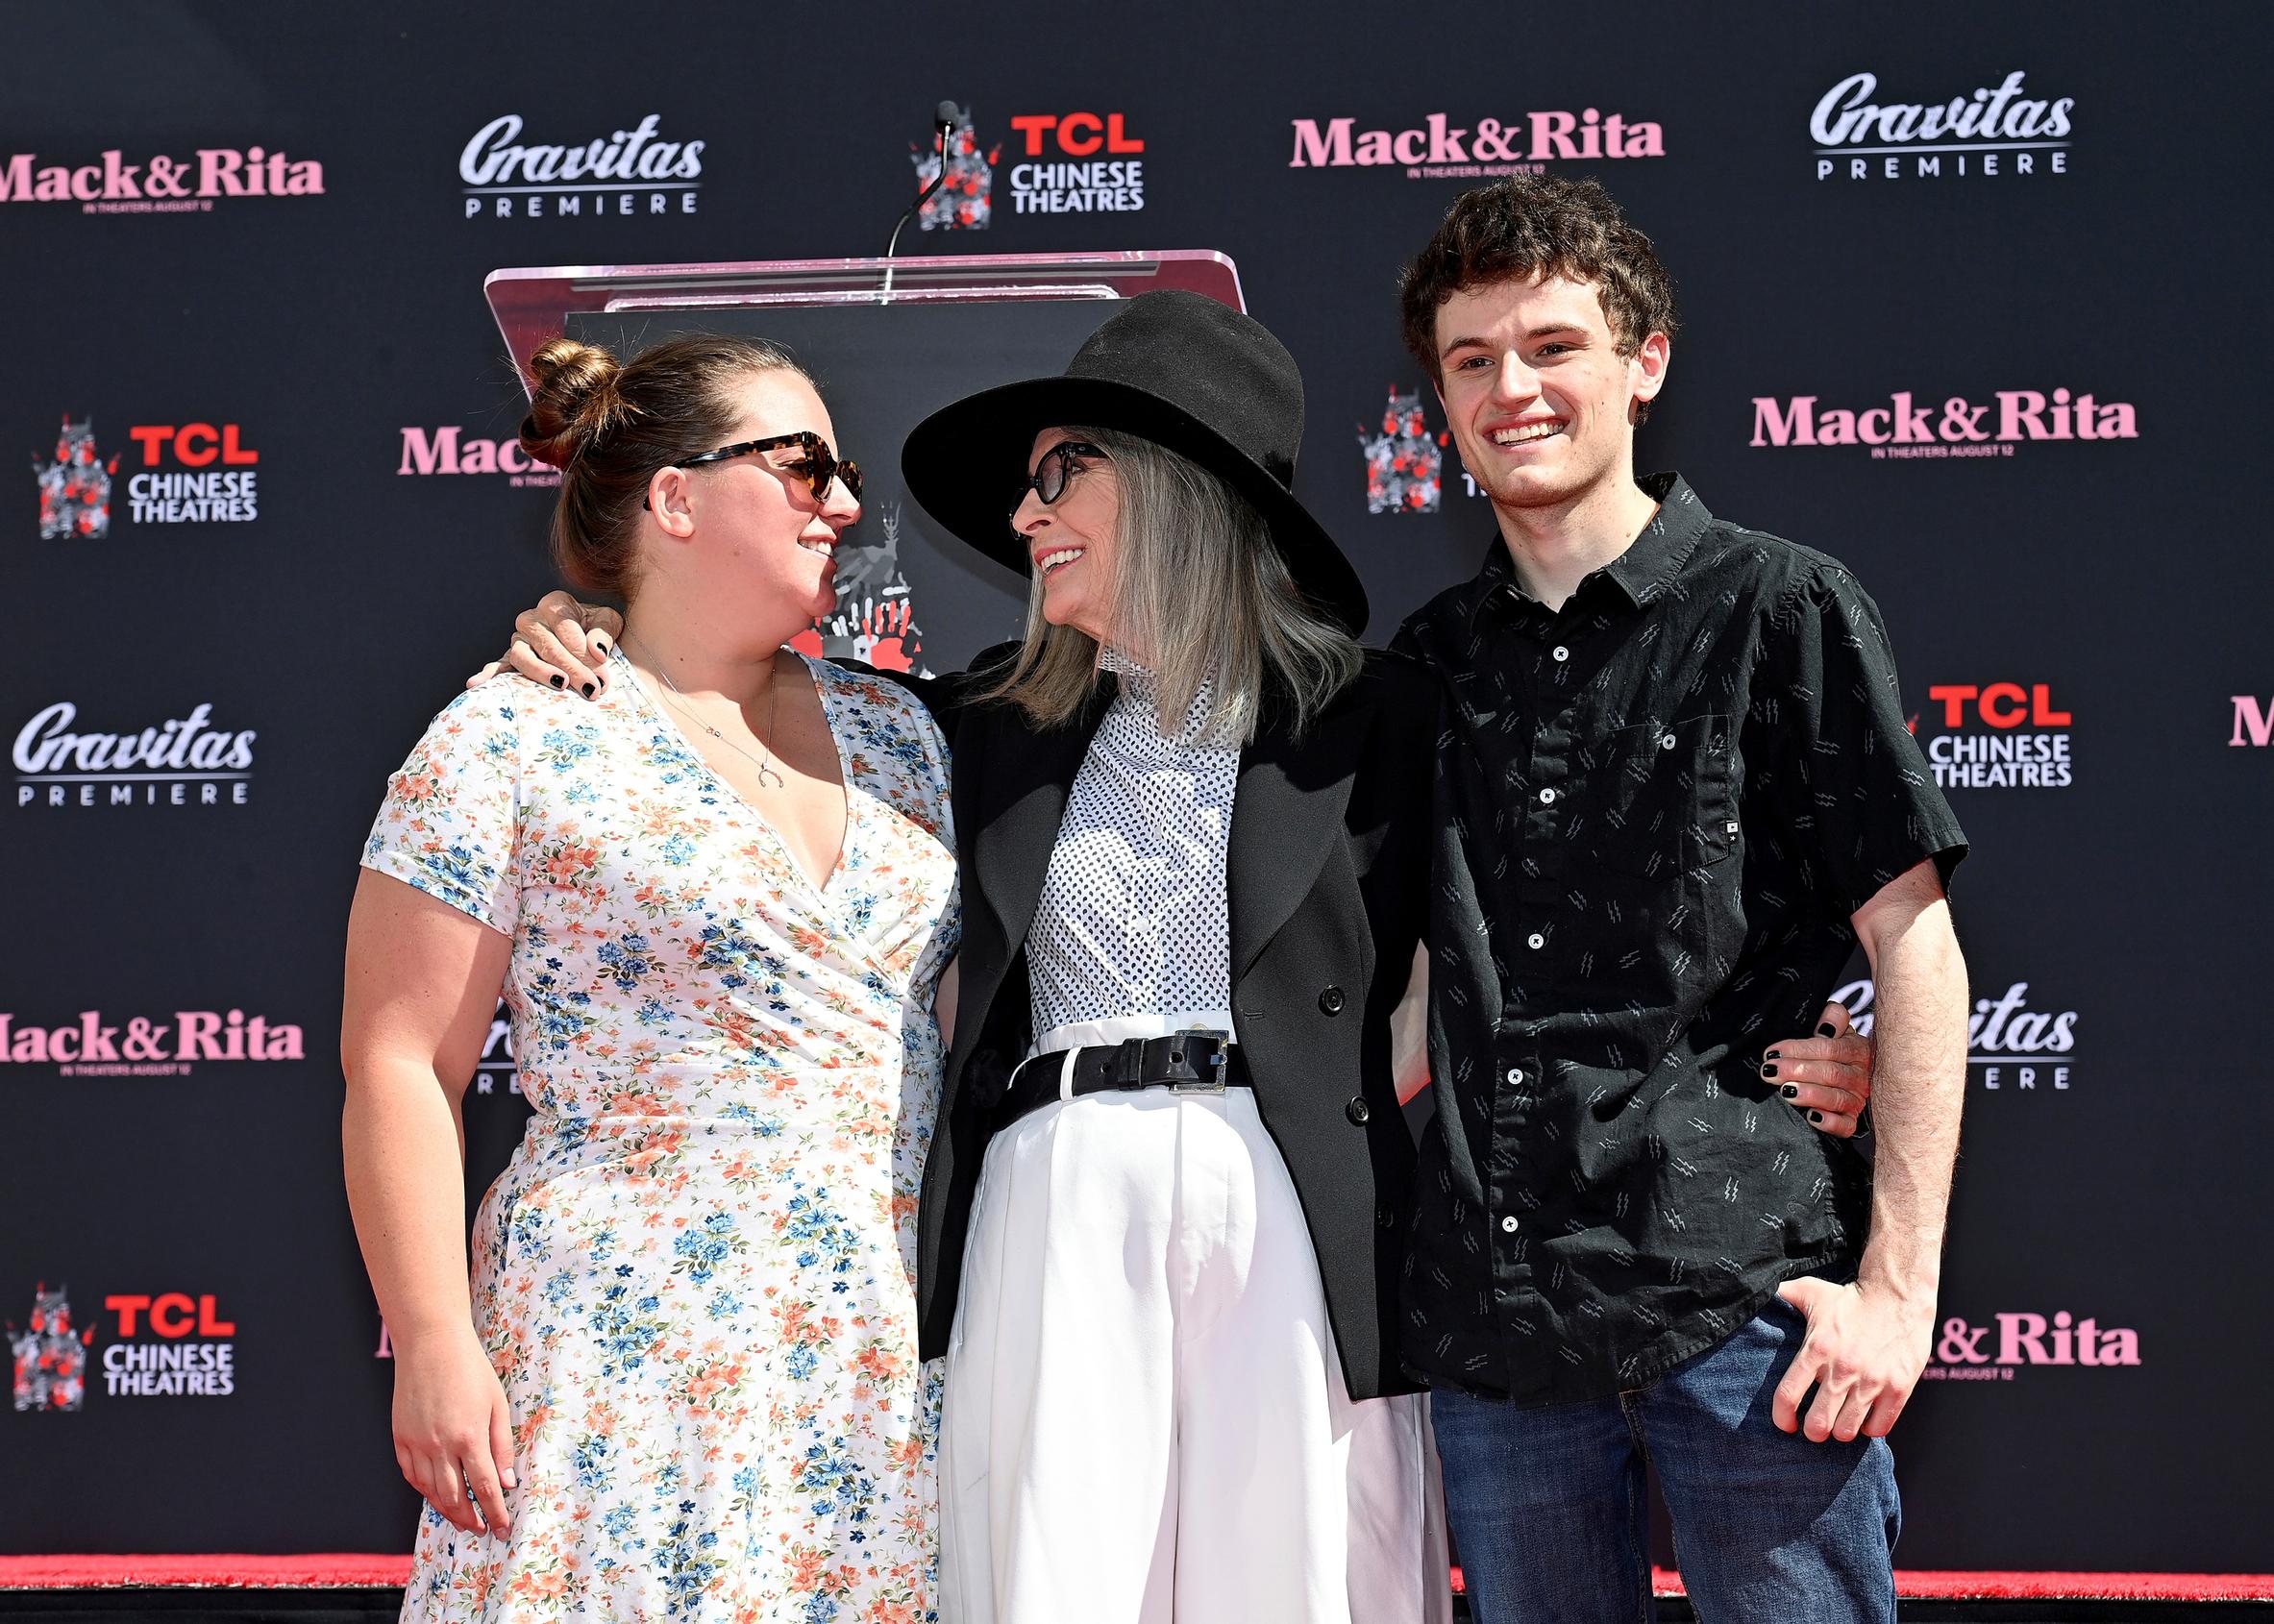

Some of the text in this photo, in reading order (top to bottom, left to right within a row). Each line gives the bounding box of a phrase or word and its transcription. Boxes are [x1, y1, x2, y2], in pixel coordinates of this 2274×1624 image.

[1810, 71, 2074, 145] Gravitas
[1011, 112, 1145, 156] TCL
[459, 114, 705, 185] Gravitas
[1010, 161, 1143, 191] CHINESE
[1817, 152, 2066, 181] PREMIERE
[466, 192, 697, 218] PREMIERE
[1010, 188, 1144, 213] THEATRES
[130, 423, 259, 467] TCL
[397, 426, 561, 475] Mac
[1871, 444, 2014, 458] IN THEATERS AUGUST 12
[129, 472, 257, 500] CHINESE
[129, 497, 258, 523] THEATRES
[1929, 682, 2072, 728] TCL
[12, 701, 257, 773] Gravitas
[1929, 734, 2071, 764] CHINESE
[1929, 762, 2072, 788] THEATRES
[19, 783, 247, 807] PREMIERE
[105, 1292, 235, 1338] TCL
[103, 1343, 234, 1371] CHINESE
[103, 1368, 235, 1396] THEATRES
[1948, 1367, 1999, 1381] AUGUST
